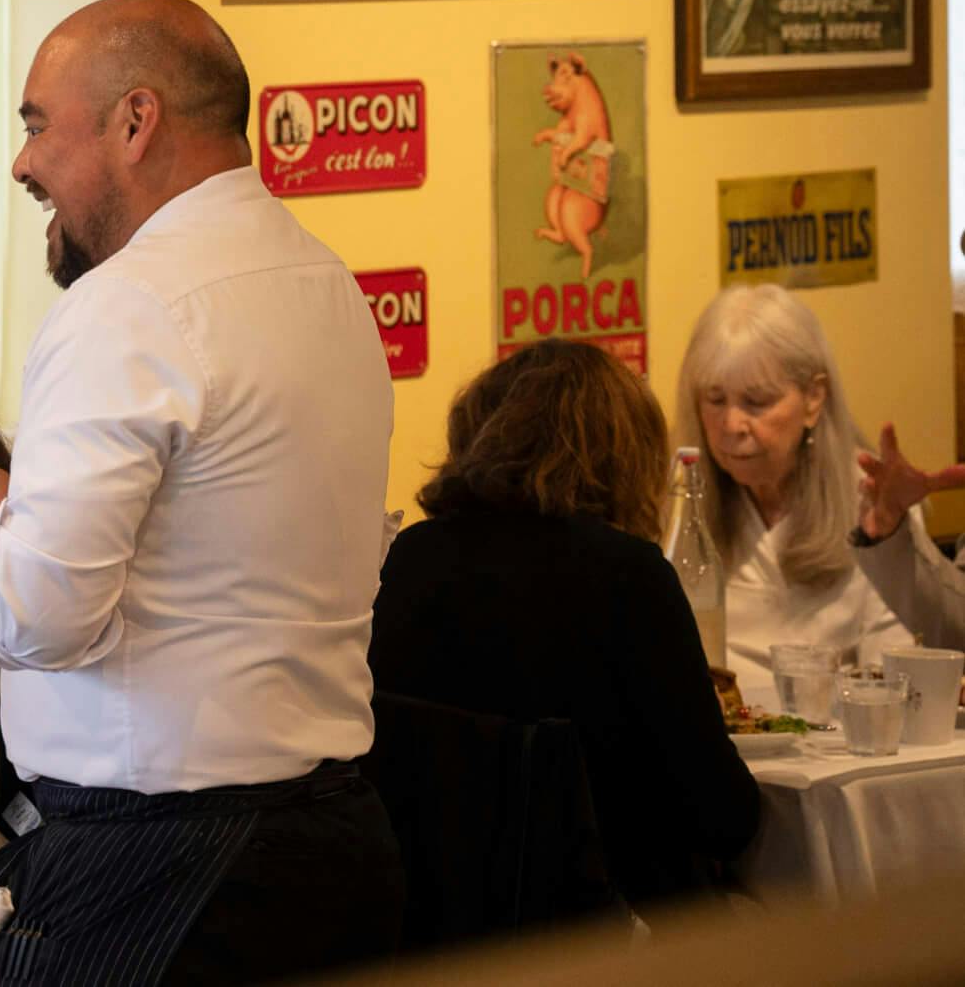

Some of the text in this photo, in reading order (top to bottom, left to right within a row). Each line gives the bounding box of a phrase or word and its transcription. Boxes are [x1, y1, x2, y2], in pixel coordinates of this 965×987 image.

[316, 93, 419, 136] PICON
[727, 208, 873, 273] PERNOD FILS
[503, 278, 642, 339] PORCA
